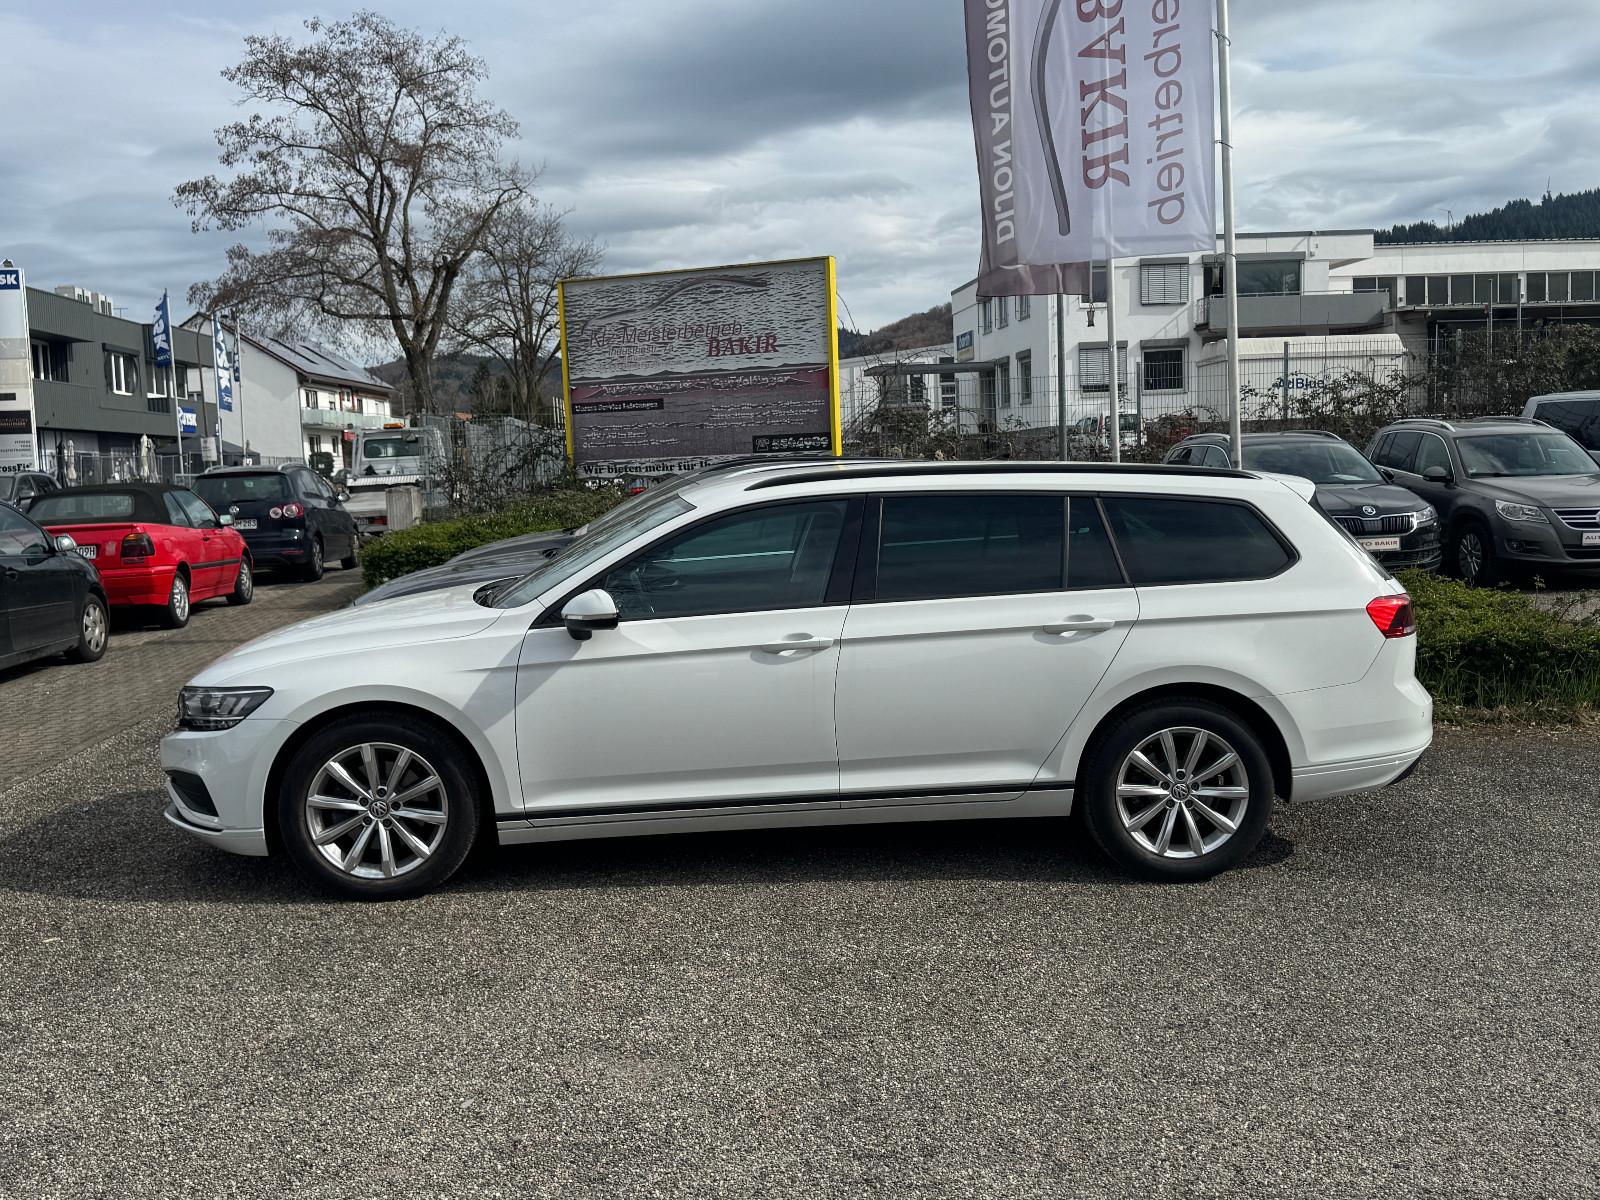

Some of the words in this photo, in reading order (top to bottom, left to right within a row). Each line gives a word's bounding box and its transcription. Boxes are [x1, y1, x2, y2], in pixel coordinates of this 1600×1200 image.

[707, 335, 779, 357] BAKIR
[583, 464, 605, 475] Wir
[607, 463, 642, 475] bieten
[644, 462, 674, 473] mehr
[678, 461, 697, 471] für
